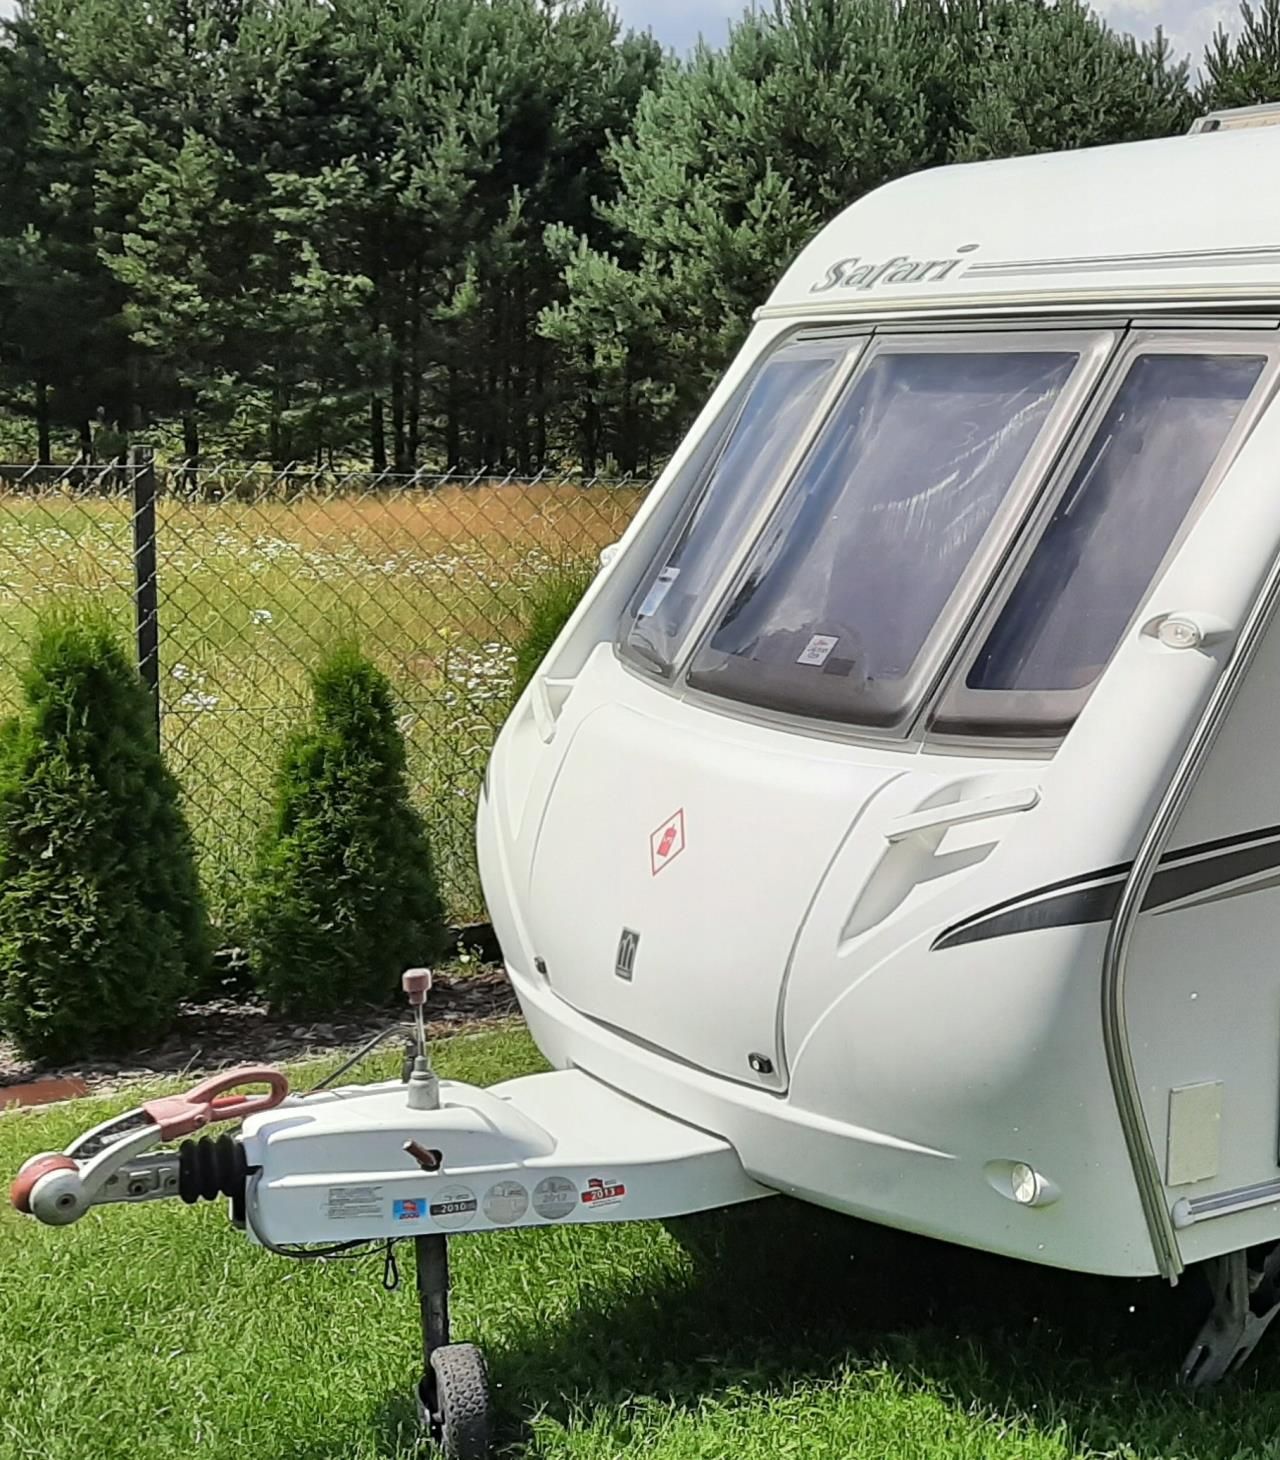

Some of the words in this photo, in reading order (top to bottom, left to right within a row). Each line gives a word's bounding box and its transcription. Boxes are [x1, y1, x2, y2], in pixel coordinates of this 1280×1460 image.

[809, 243, 980, 294] Safari
[591, 1188, 616, 1200] 2013
[440, 1202, 467, 1213] 2010
